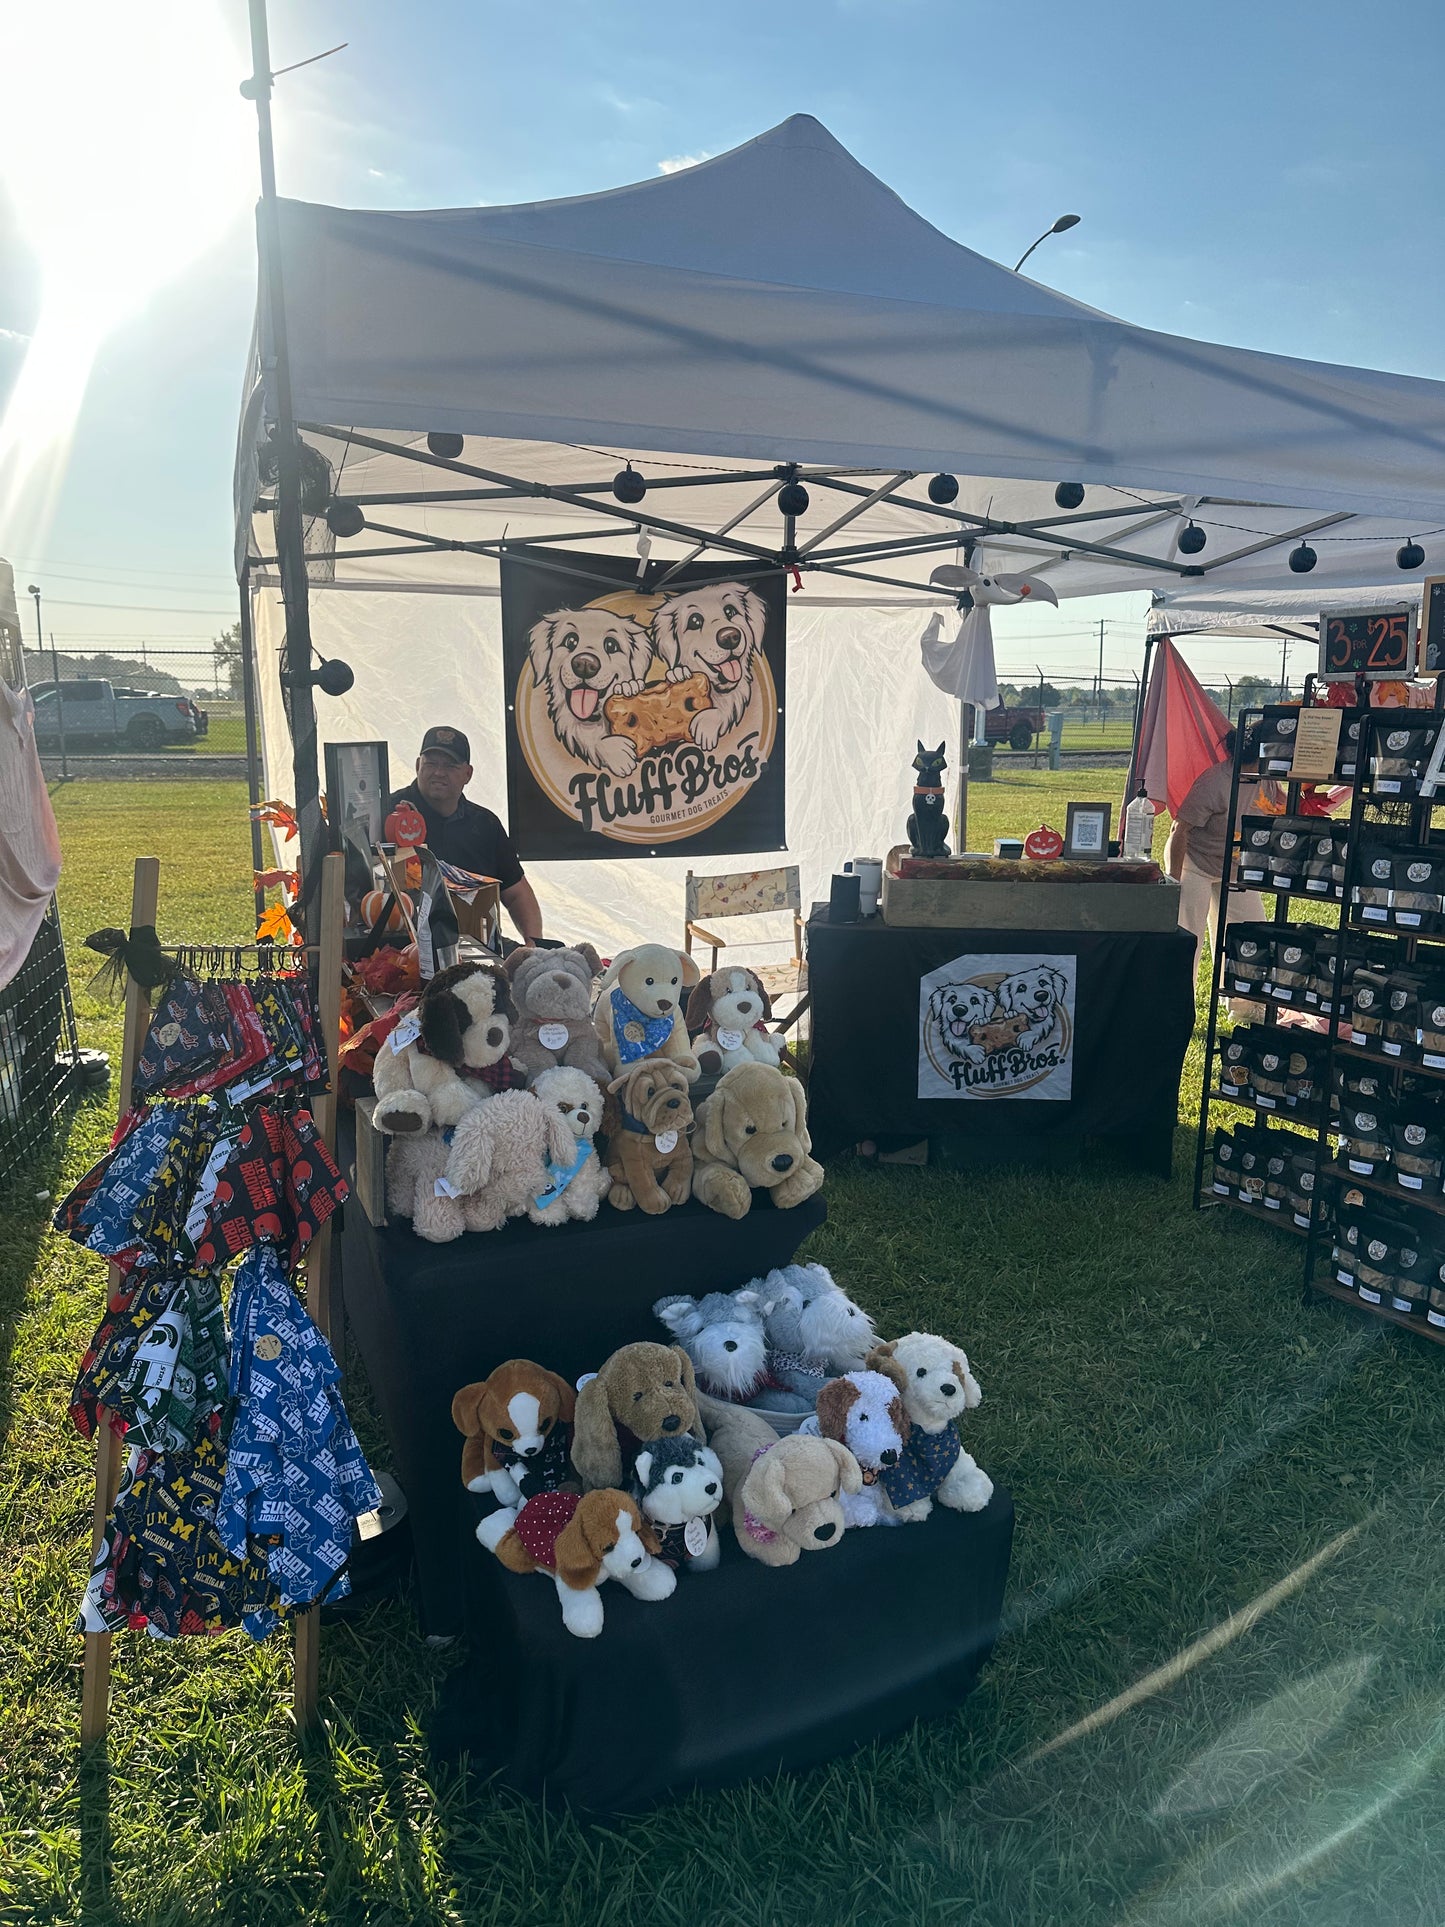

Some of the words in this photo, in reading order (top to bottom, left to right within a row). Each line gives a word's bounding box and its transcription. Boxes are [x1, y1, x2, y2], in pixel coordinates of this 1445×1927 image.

[1329, 620, 1351, 666] 3
[1353, 639, 1367, 650] FOR
[1366, 616, 1407, 666] $25
[650, 810, 686, 824] GOURMET
[688, 805, 703, 816] DOG
[703, 790, 729, 809] TREATS
[239, 1161, 268, 1211] BROWNS
[253, 1157, 277, 1206] CLEVELAND
[266, 1317, 298, 1350] LIONS
[203, 1371, 218, 1391] S
[170, 1476, 192, 1500] M
[312, 1503, 337, 1525] DETROIT
[169, 1516, 195, 1543] M
[313, 1548, 340, 1571] DETROIT
